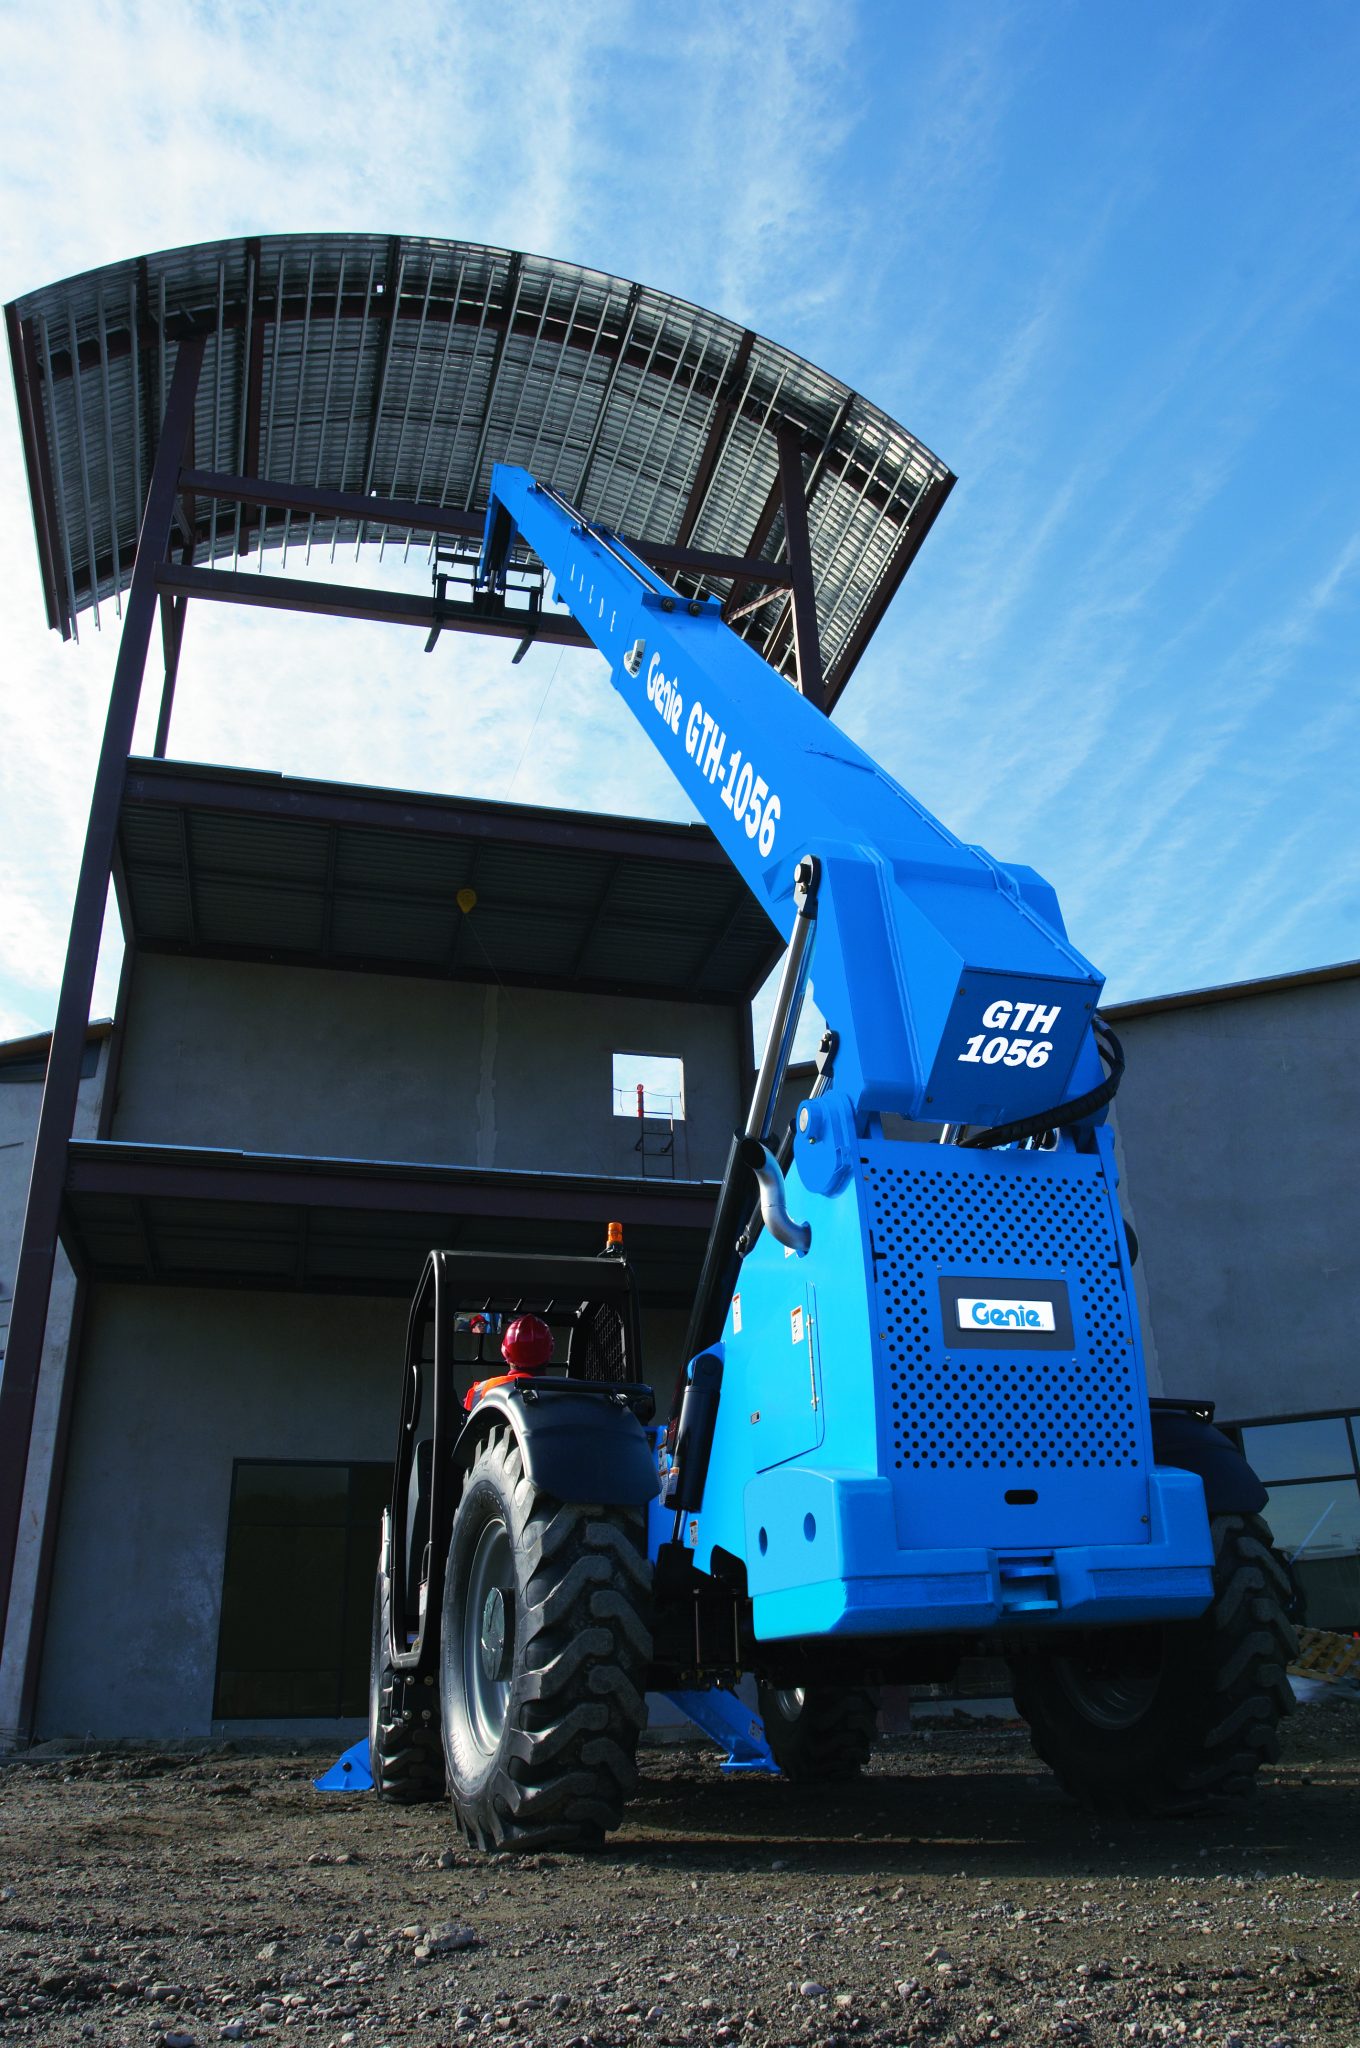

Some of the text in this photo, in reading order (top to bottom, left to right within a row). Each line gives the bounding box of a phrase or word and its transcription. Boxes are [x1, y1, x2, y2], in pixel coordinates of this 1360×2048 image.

[647, 652, 781, 857] Genie GTH-1056
[982, 1000, 1062, 1034] GTH
[957, 1034, 1053, 1069] 1056
[971, 1302, 1041, 1327] Genie
